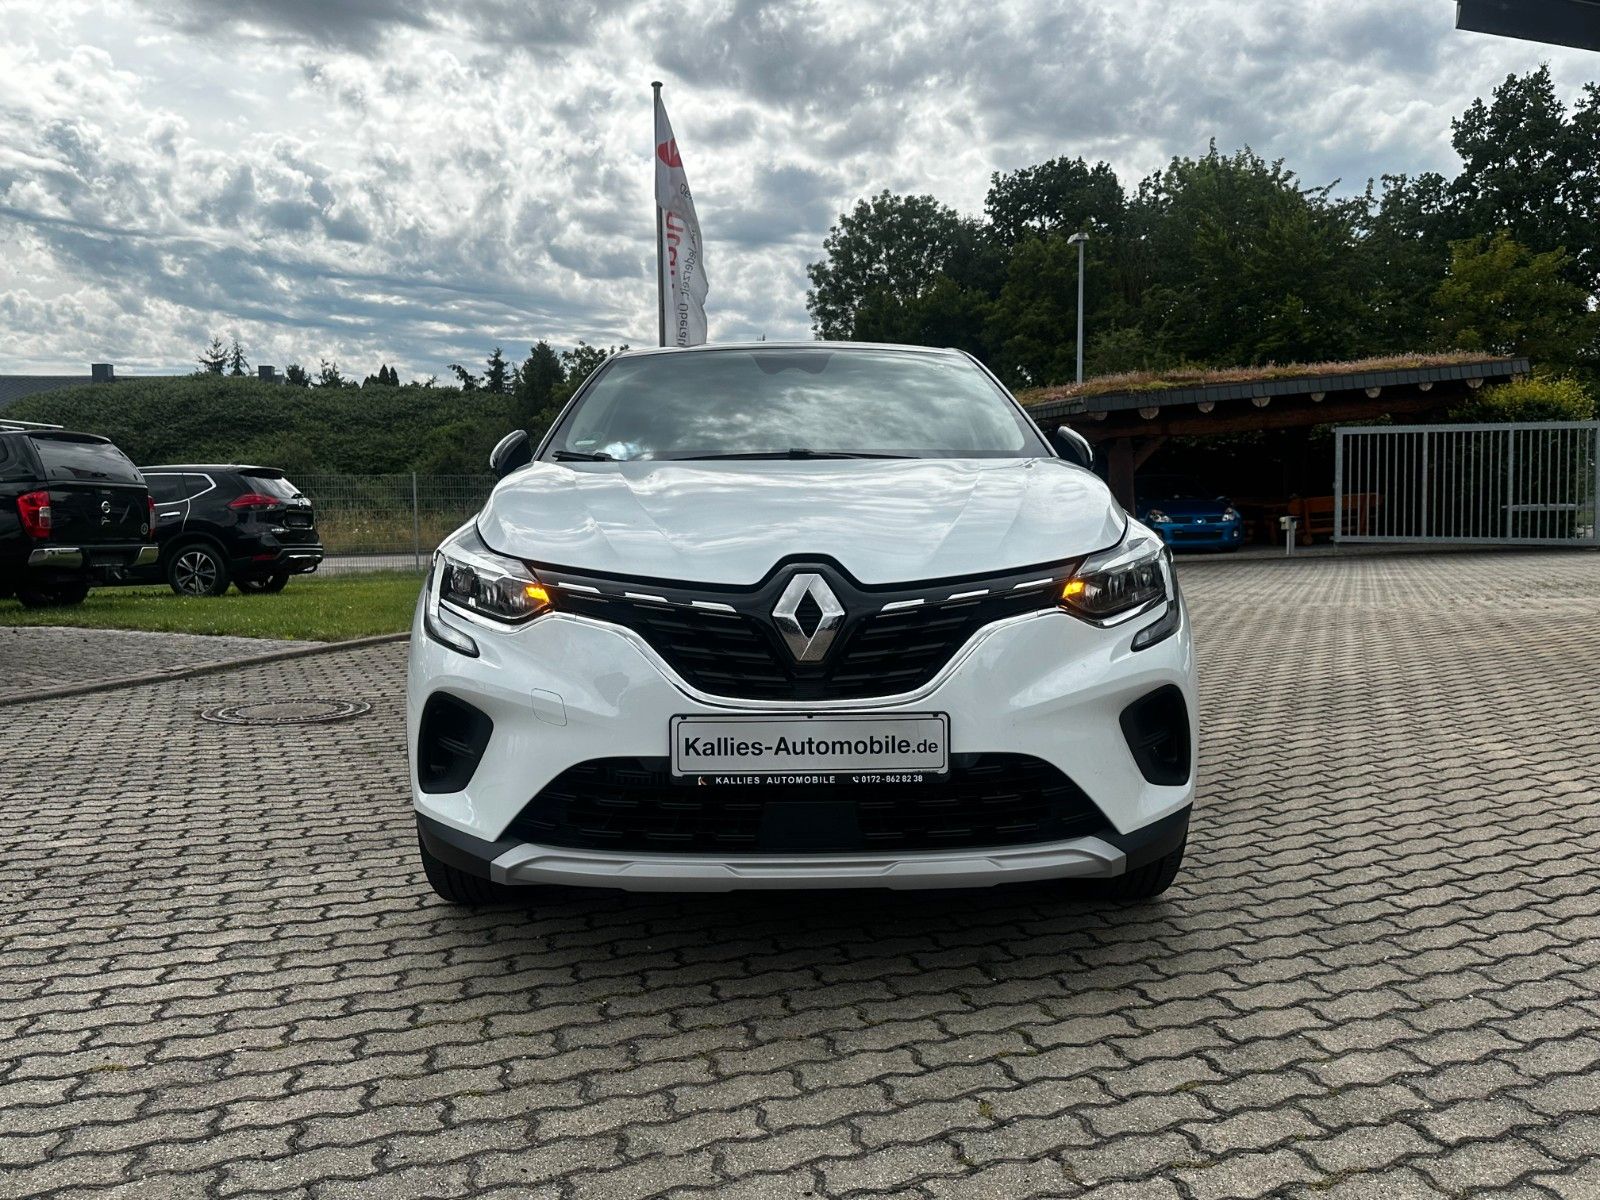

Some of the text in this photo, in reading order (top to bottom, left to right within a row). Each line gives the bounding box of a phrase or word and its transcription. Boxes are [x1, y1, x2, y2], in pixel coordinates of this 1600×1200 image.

[684, 735, 940, 757] Kallies-Automobile.de
[715, 776, 760, 785] KALLIES
[766, 775, 836, 785] AUTOMOBILE
